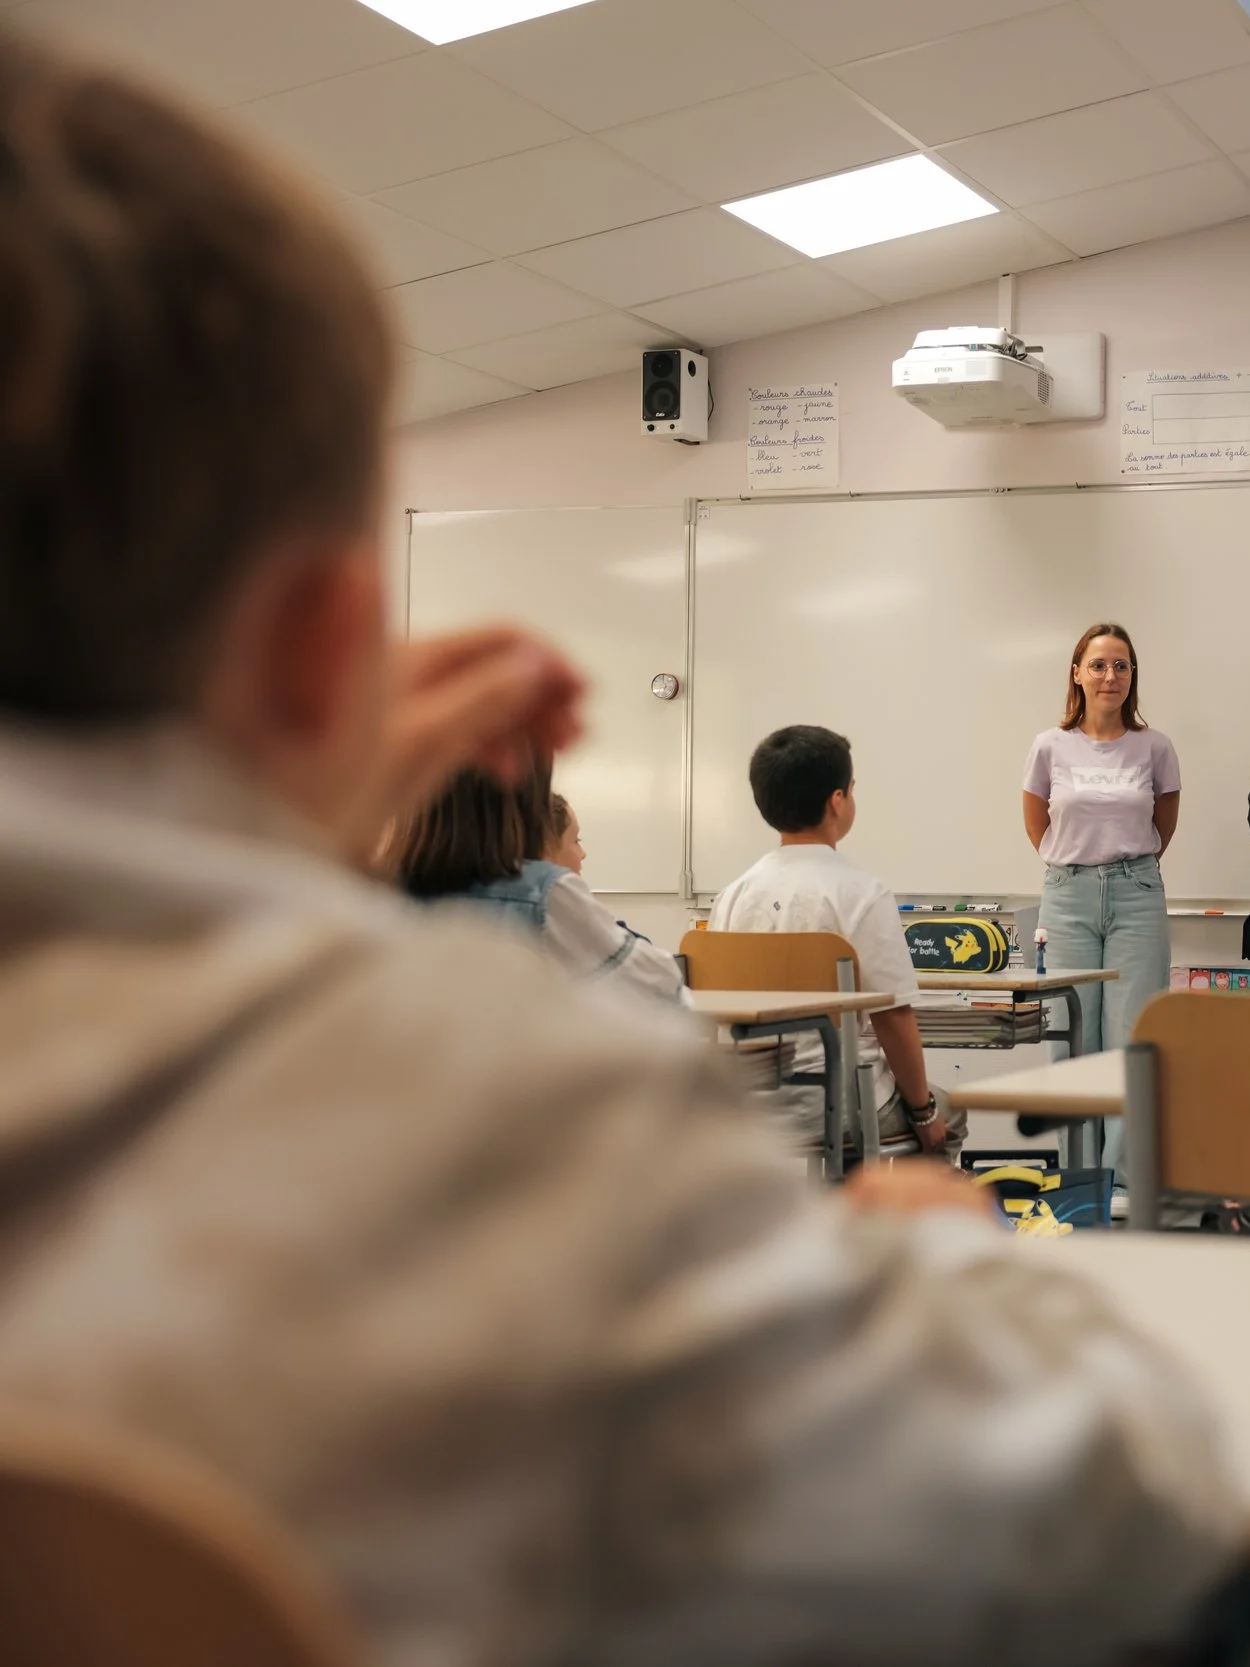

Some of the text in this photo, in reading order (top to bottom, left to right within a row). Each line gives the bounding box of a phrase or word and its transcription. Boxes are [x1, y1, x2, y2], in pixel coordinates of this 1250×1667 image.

[751, 386, 834, 400] Couleurs chaudes
[759, 404, 788, 418] rouge
[803, 400, 834, 416] jaune
[1125, 399, 1148, 412] Tout
[758, 419, 790, 431] orange
[803, 415, 837, 423] marron
[1121, 423, 1151, 435] Parties
[749, 430, 825, 450] Couleurs froides
[755, 449, 779, 461] bleu
[800, 449, 823, 458] vert
[1124, 452, 1138, 462] La
[1167, 451, 1179, 460] des
[1180, 449, 1208, 467] parties
[1209, 450, 1222, 458] est
[1225, 446, 1250, 461] égale
[755, 462, 783, 475] violet
[799, 463, 823, 471] rose
[1126, 464, 1140, 472] au
[914, 938, 934, 947] Ready
[919, 947, 940, 957] battle
